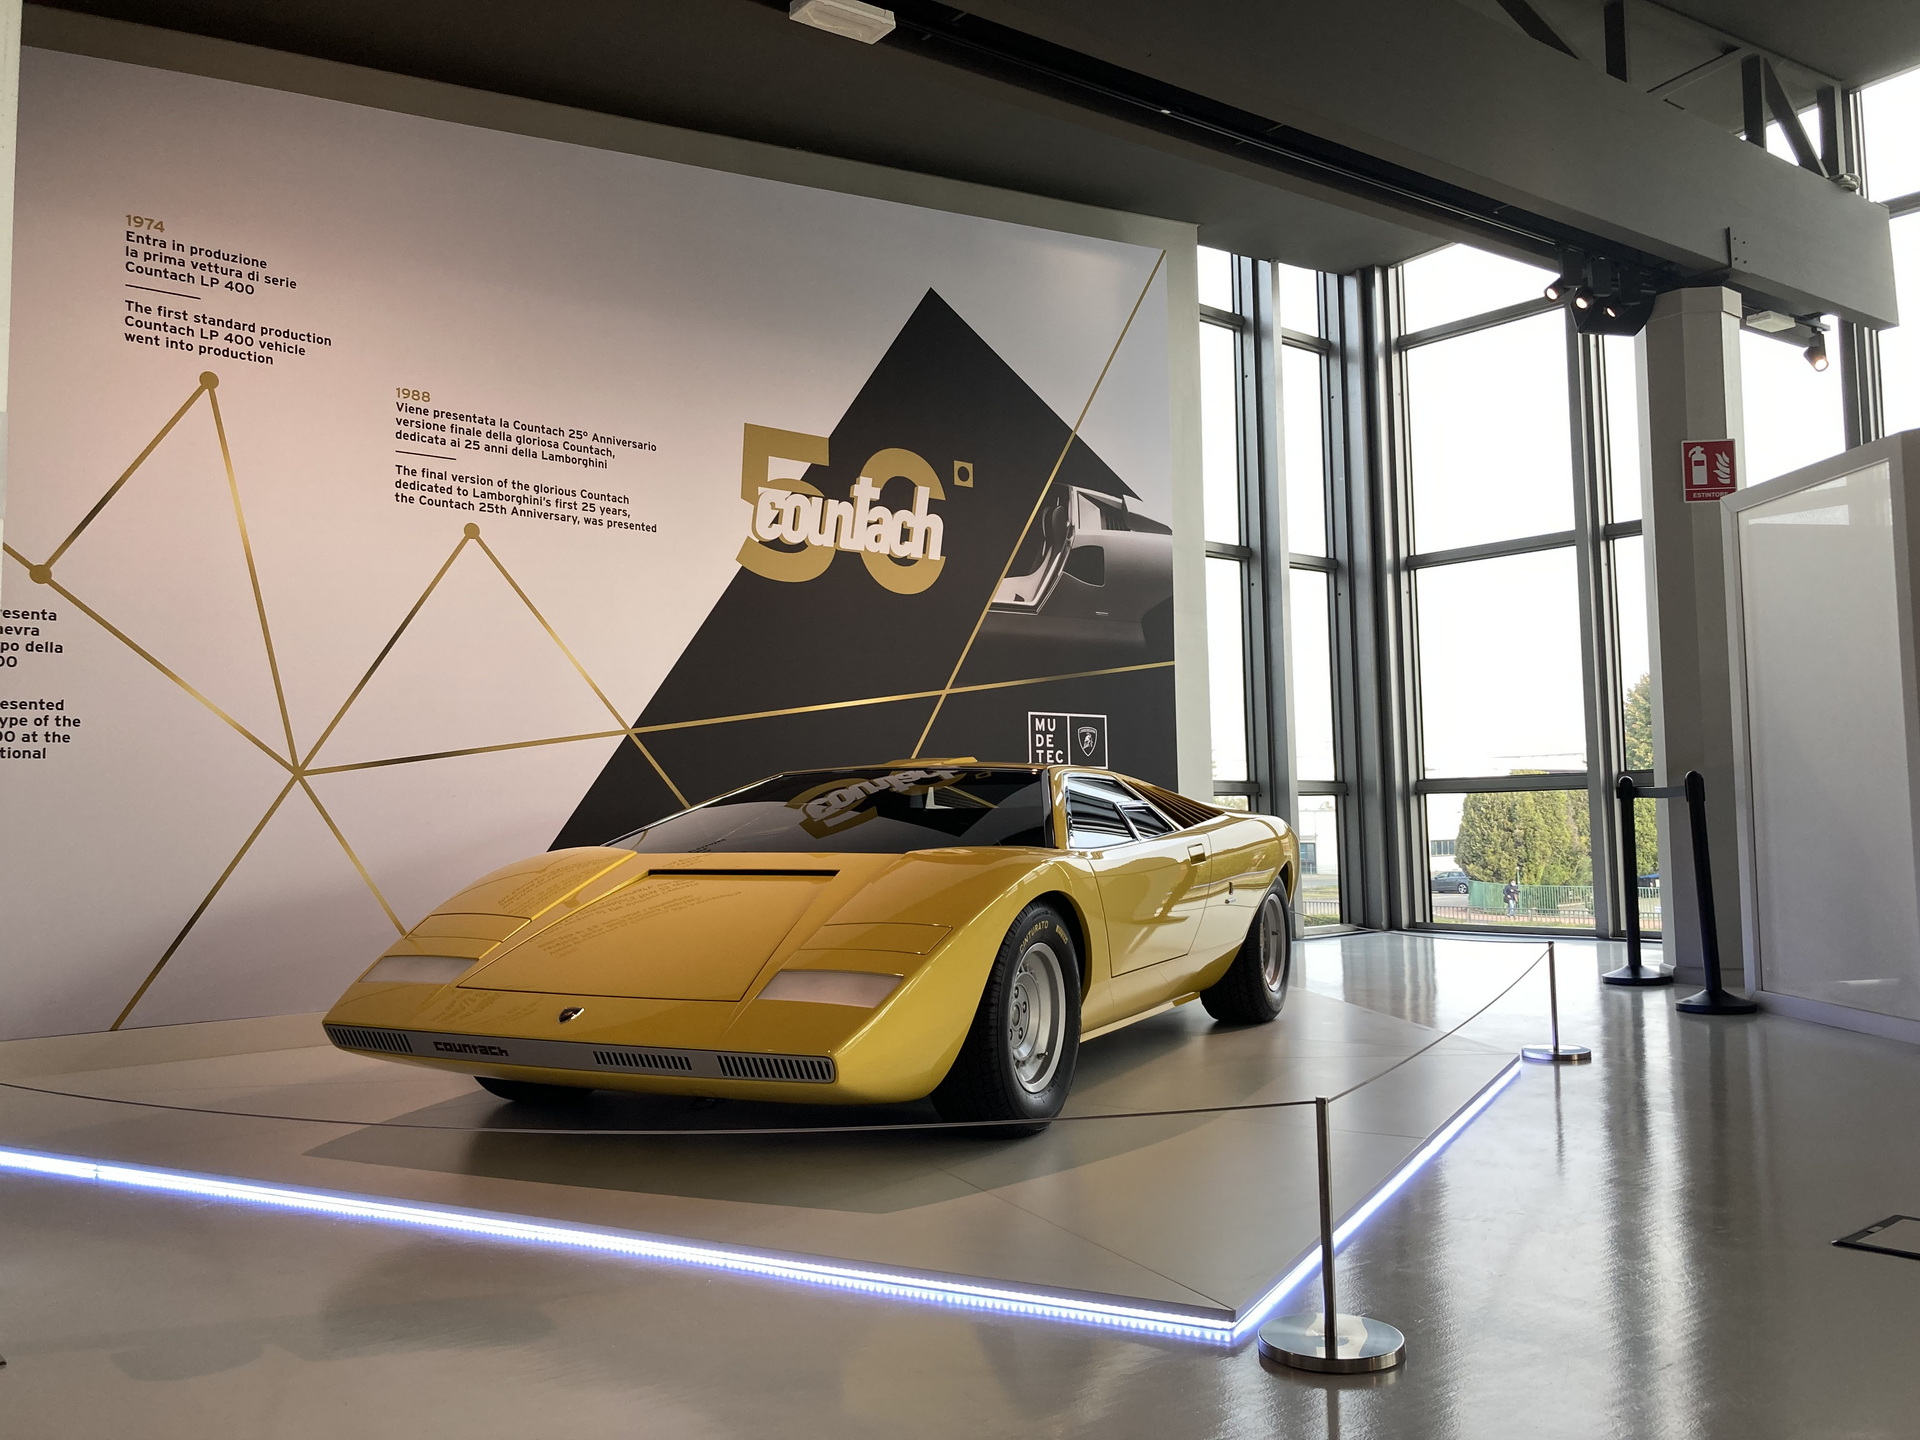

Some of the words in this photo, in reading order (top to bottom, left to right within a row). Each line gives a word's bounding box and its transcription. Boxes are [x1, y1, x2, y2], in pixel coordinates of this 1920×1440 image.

[125, 214, 165, 232] 1974
[126, 231, 167, 248] Entra
[172, 240, 185, 252] in
[190, 246, 268, 269] produzione
[126, 246, 138, 258] la
[144, 250, 186, 268] prima
[191, 260, 243, 278] vettura
[248, 271, 260, 282] di
[264, 275, 297, 289] serie
[126, 262, 195, 284] Countach
[201, 276, 220, 288] LP
[224, 281, 254, 295] 400
[124, 316, 194, 338] Countach
[200, 328, 219, 340] LP
[224, 334, 254, 347] 400
[259, 340, 306, 356] vehicle
[125, 300, 152, 314] The
[157, 306, 188, 321] first
[194, 314, 256, 332] standard
[261, 325, 332, 346] production
[124, 332, 160, 346] went
[166, 338, 194, 352] into
[199, 345, 274, 365] production
[396, 388, 431, 402] 1988
[396, 402, 430, 416] Viene
[434, 409, 496, 426] presentata
[500, 418, 510, 428] la
[513, 420, 565, 437] Countach
[592, 432, 657, 452] Anniversario
[396, 417, 446, 432] versione
[450, 424, 482, 438] finale
[486, 430, 512, 442] della
[516, 434, 559, 449] gloriosa
[562, 441, 616, 460] Countach,
[395, 430, 446, 446] dedicata
[450, 438, 460, 448] ai
[464, 440, 480, 450] 25
[484, 444, 508, 454] anni
[512, 447, 538, 459] della
[542, 450, 608, 469] Lamborghini
[394, 478, 453, 495] dedicated
[457, 486, 469, 497] to
[472, 488, 552, 508] Lamborghini's
[554, 498, 578, 511] first
[581, 502, 596, 513] 25
[600, 506, 631, 519] years,
[395, 464, 418, 476] The
[421, 468, 448, 480] final
[451, 474, 494, 486] version
[497, 478, 508, 488] of
[512, 480, 530, 491] the
[533, 484, 577, 498] glorious
[580, 488, 630, 505] Countach
[394, 492, 414, 504] the
[419, 495, 475, 511] Countach
[478, 502, 507, 515] 25th
[510, 506, 580, 526] Anniversary,
[584, 516, 604, 527] was
[606, 519, 658, 533] presented
[0, 608, 58, 621] esenta
[25, 640, 64, 654] della
[21, 731, 38, 742] at
[44, 731, 71, 743] the
[34, 714, 50, 726] of
[54, 716, 81, 727] the
[1035, 718, 1056, 732] MU
[1036, 734, 1054, 748] DE
[1036, 750, 1064, 763] TEC
[1020, 920, 1049, 954] CINTURATO
